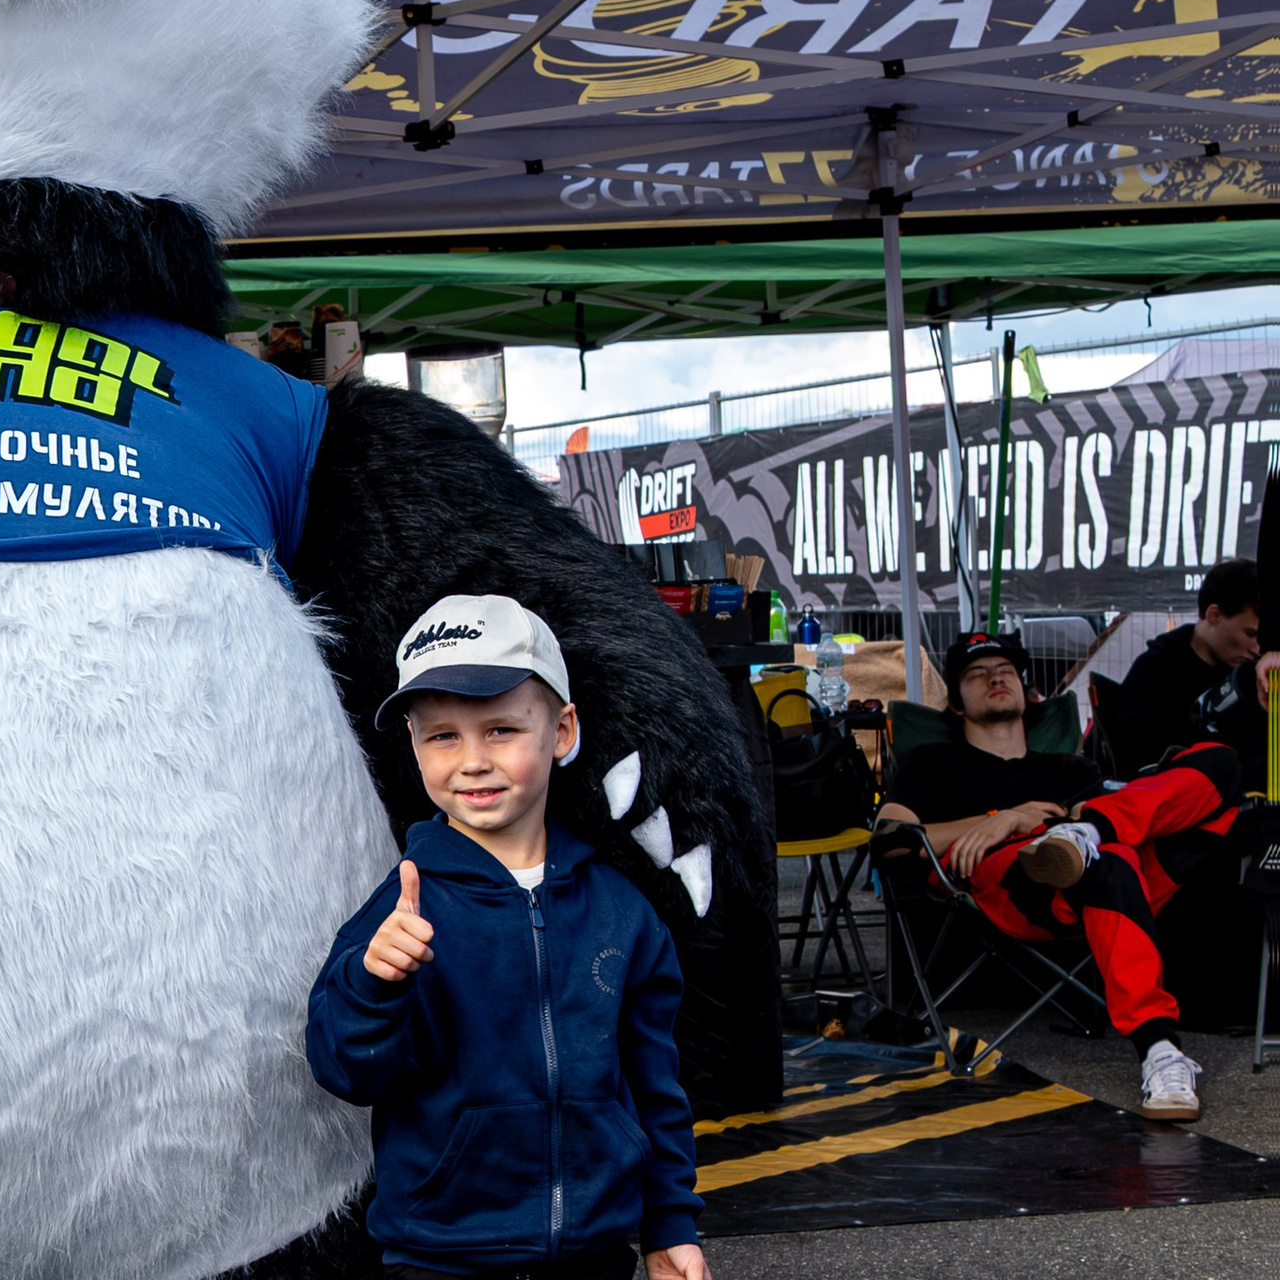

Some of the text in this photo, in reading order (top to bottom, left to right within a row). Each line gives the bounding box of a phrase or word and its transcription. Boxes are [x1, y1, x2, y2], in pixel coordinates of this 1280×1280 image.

[640, 463, 696, 516] DRIFT
[793, 459, 854, 576] ALL
[1061, 430, 1112, 570] IS
[669, 509, 691, 530] EXPO
[437, 641, 458, 649] TEAM
